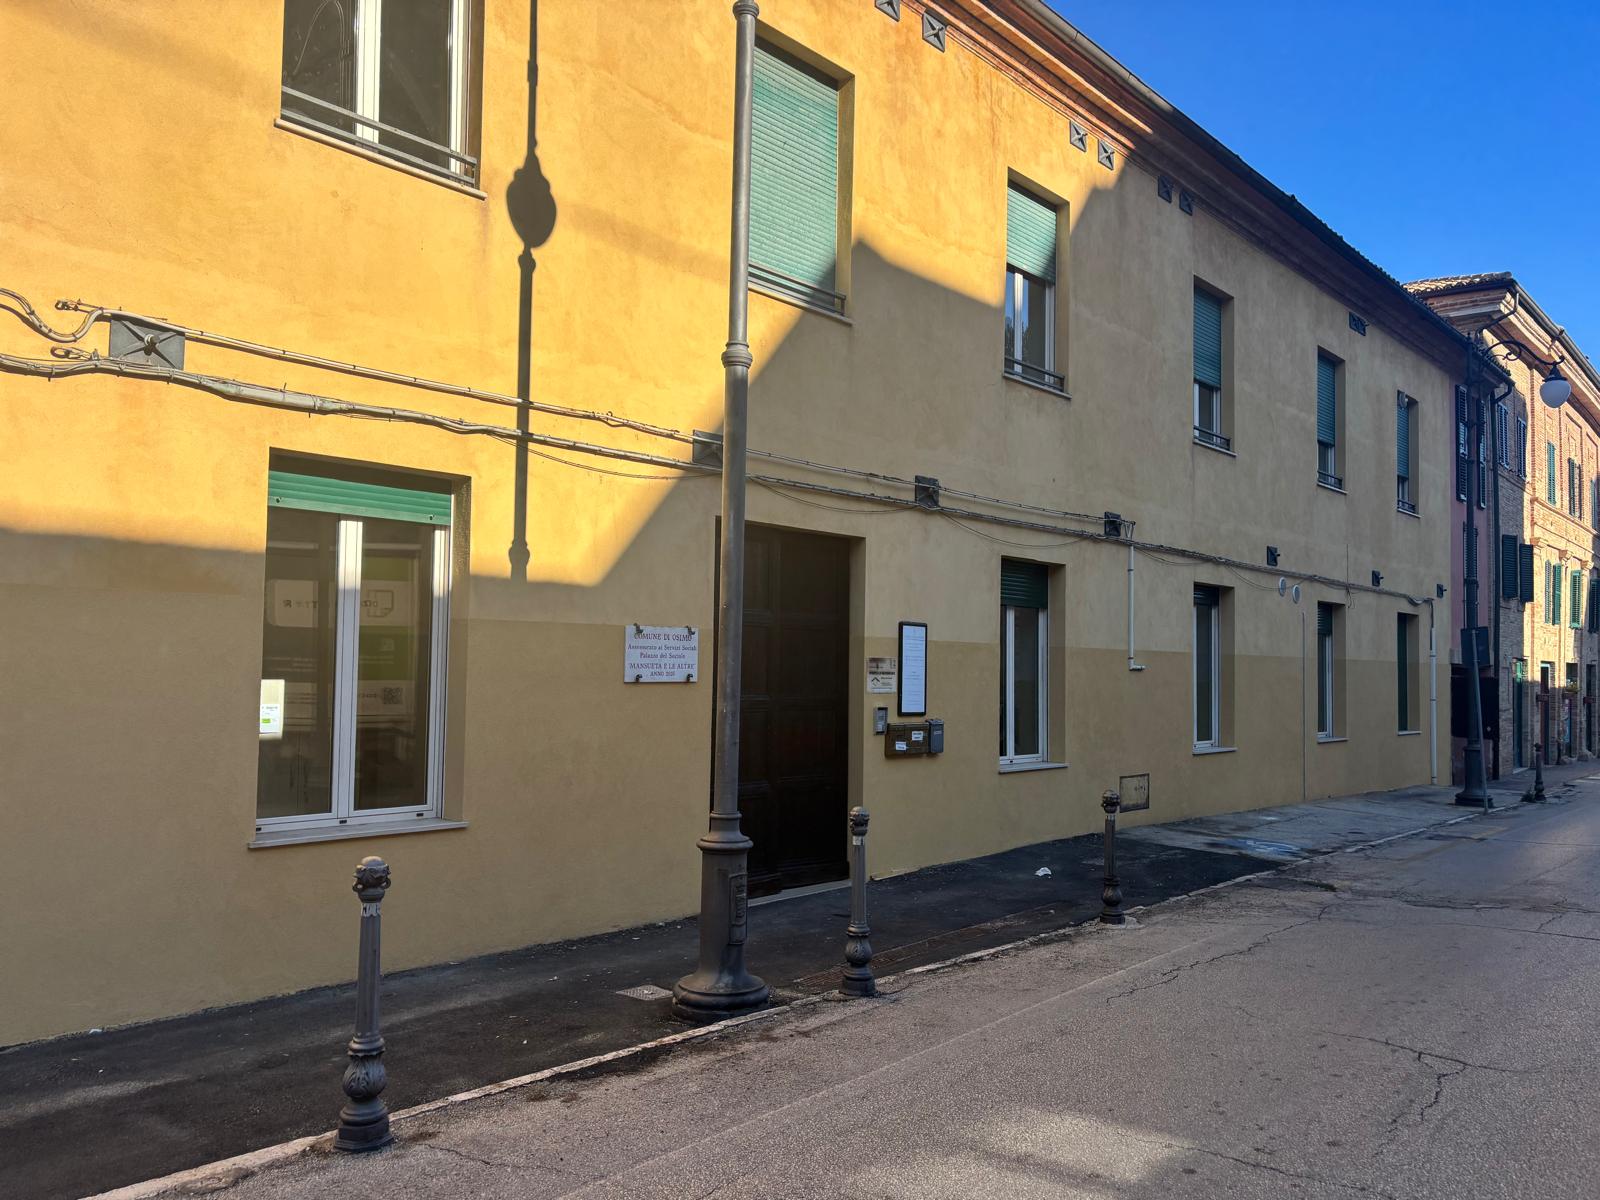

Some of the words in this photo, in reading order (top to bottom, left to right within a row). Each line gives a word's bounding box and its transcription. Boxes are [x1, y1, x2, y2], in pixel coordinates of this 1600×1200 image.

[634, 633, 662, 641] COMUNE
[663, 633, 671, 641] DI
[672, 633, 693, 642] OSIMO
